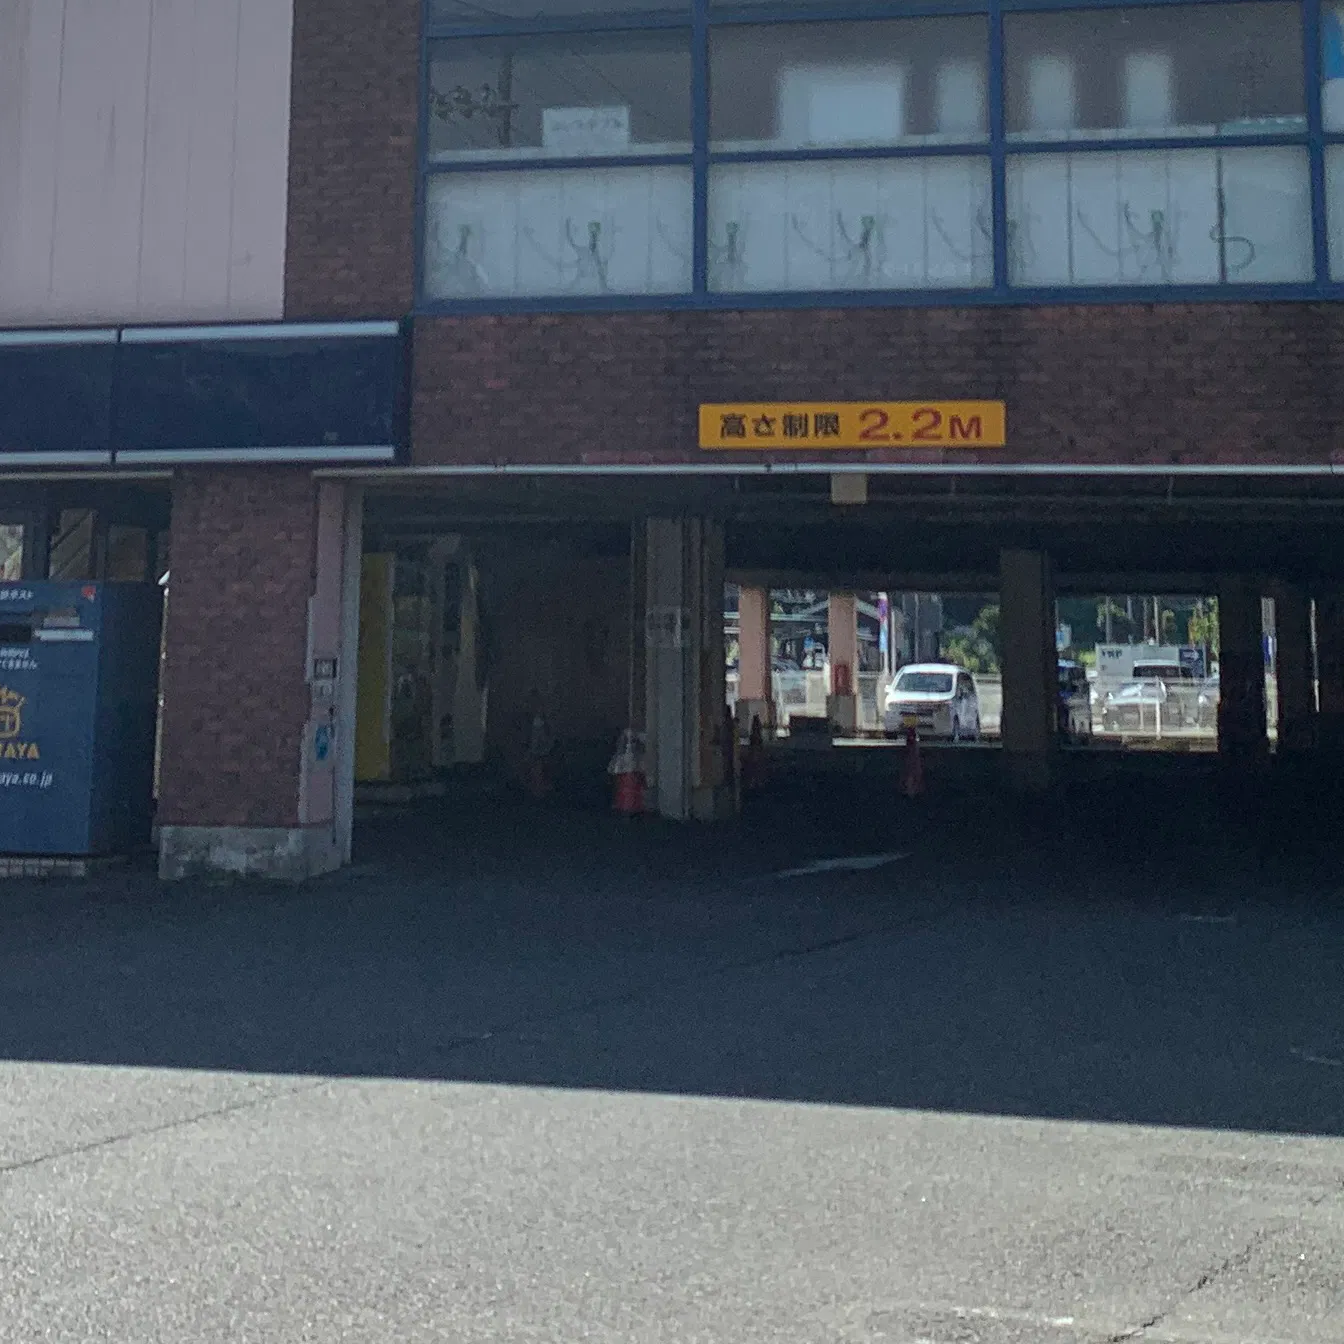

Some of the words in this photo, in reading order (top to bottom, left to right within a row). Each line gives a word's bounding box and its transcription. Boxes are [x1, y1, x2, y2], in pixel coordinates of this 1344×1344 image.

[719, 412, 840, 440] 高さ制限
[858, 408, 983, 442] 2.2M
